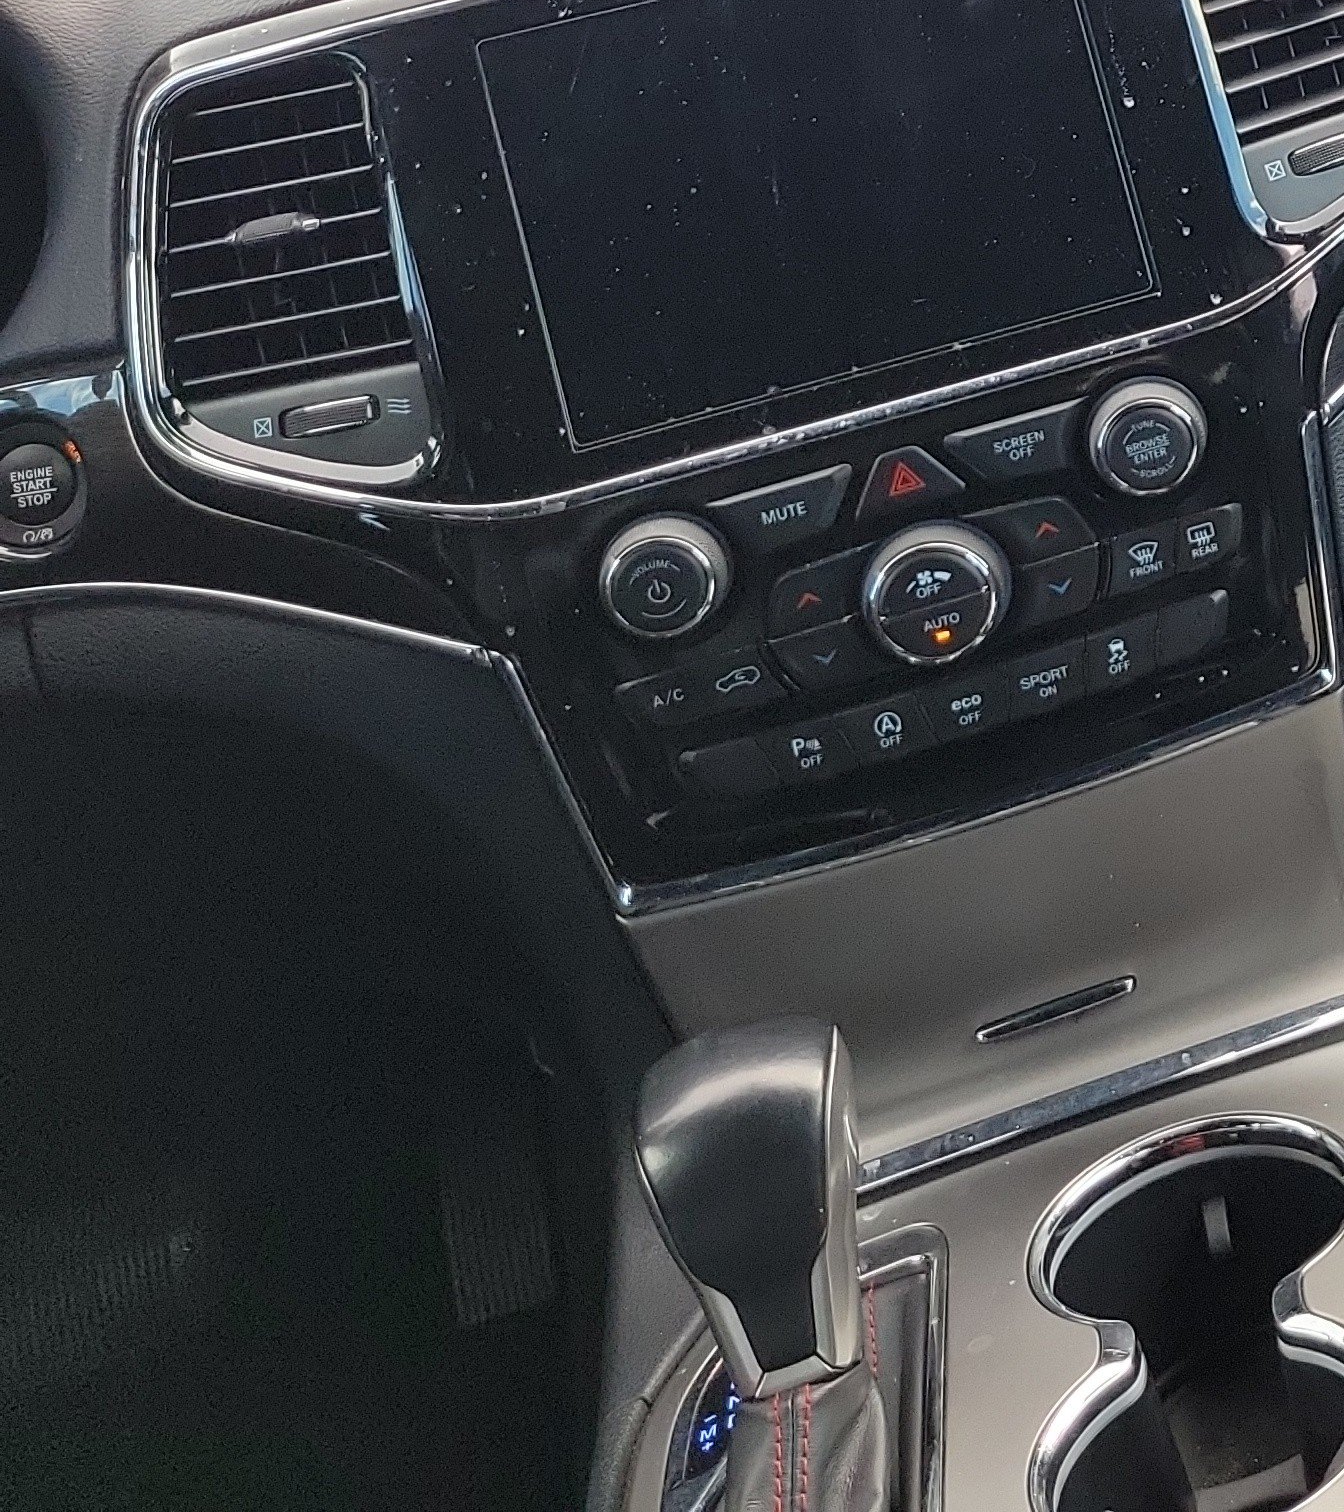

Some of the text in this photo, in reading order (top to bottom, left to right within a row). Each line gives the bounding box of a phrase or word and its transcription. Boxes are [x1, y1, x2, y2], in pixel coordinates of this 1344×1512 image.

[993, 429, 1045, 453] SCREEN
[1125, 434, 1170, 455] BROWSE
[1009, 445, 1035, 461] OFF
[1134, 447, 1167, 465] ENTER
[10, 466, 53, 483] ENGINE
[1139, 463, 1173, 478] SCROLL
[13, 477, 53, 493] START
[17, 492, 52, 508] STOP
[760, 500, 807, 526] MUTE
[1191, 543, 1219, 559] REAR
[632, 559, 671, 578] VOLUME
[1129, 560, 1164, 579] FRONT
[916, 582, 942, 599] OFF
[923, 612, 960, 633] AUTO
[1108, 660, 1131, 675] OFF
[1019, 665, 1069, 690] SPORT
[653, 688, 685, 708] A/C
[1039, 684, 1058, 698] ON
[951, 694, 982, 712] eco
[959, 710, 982, 726] OFF
[880, 734, 903, 749] OFF
[801, 753, 823, 769] OFF
